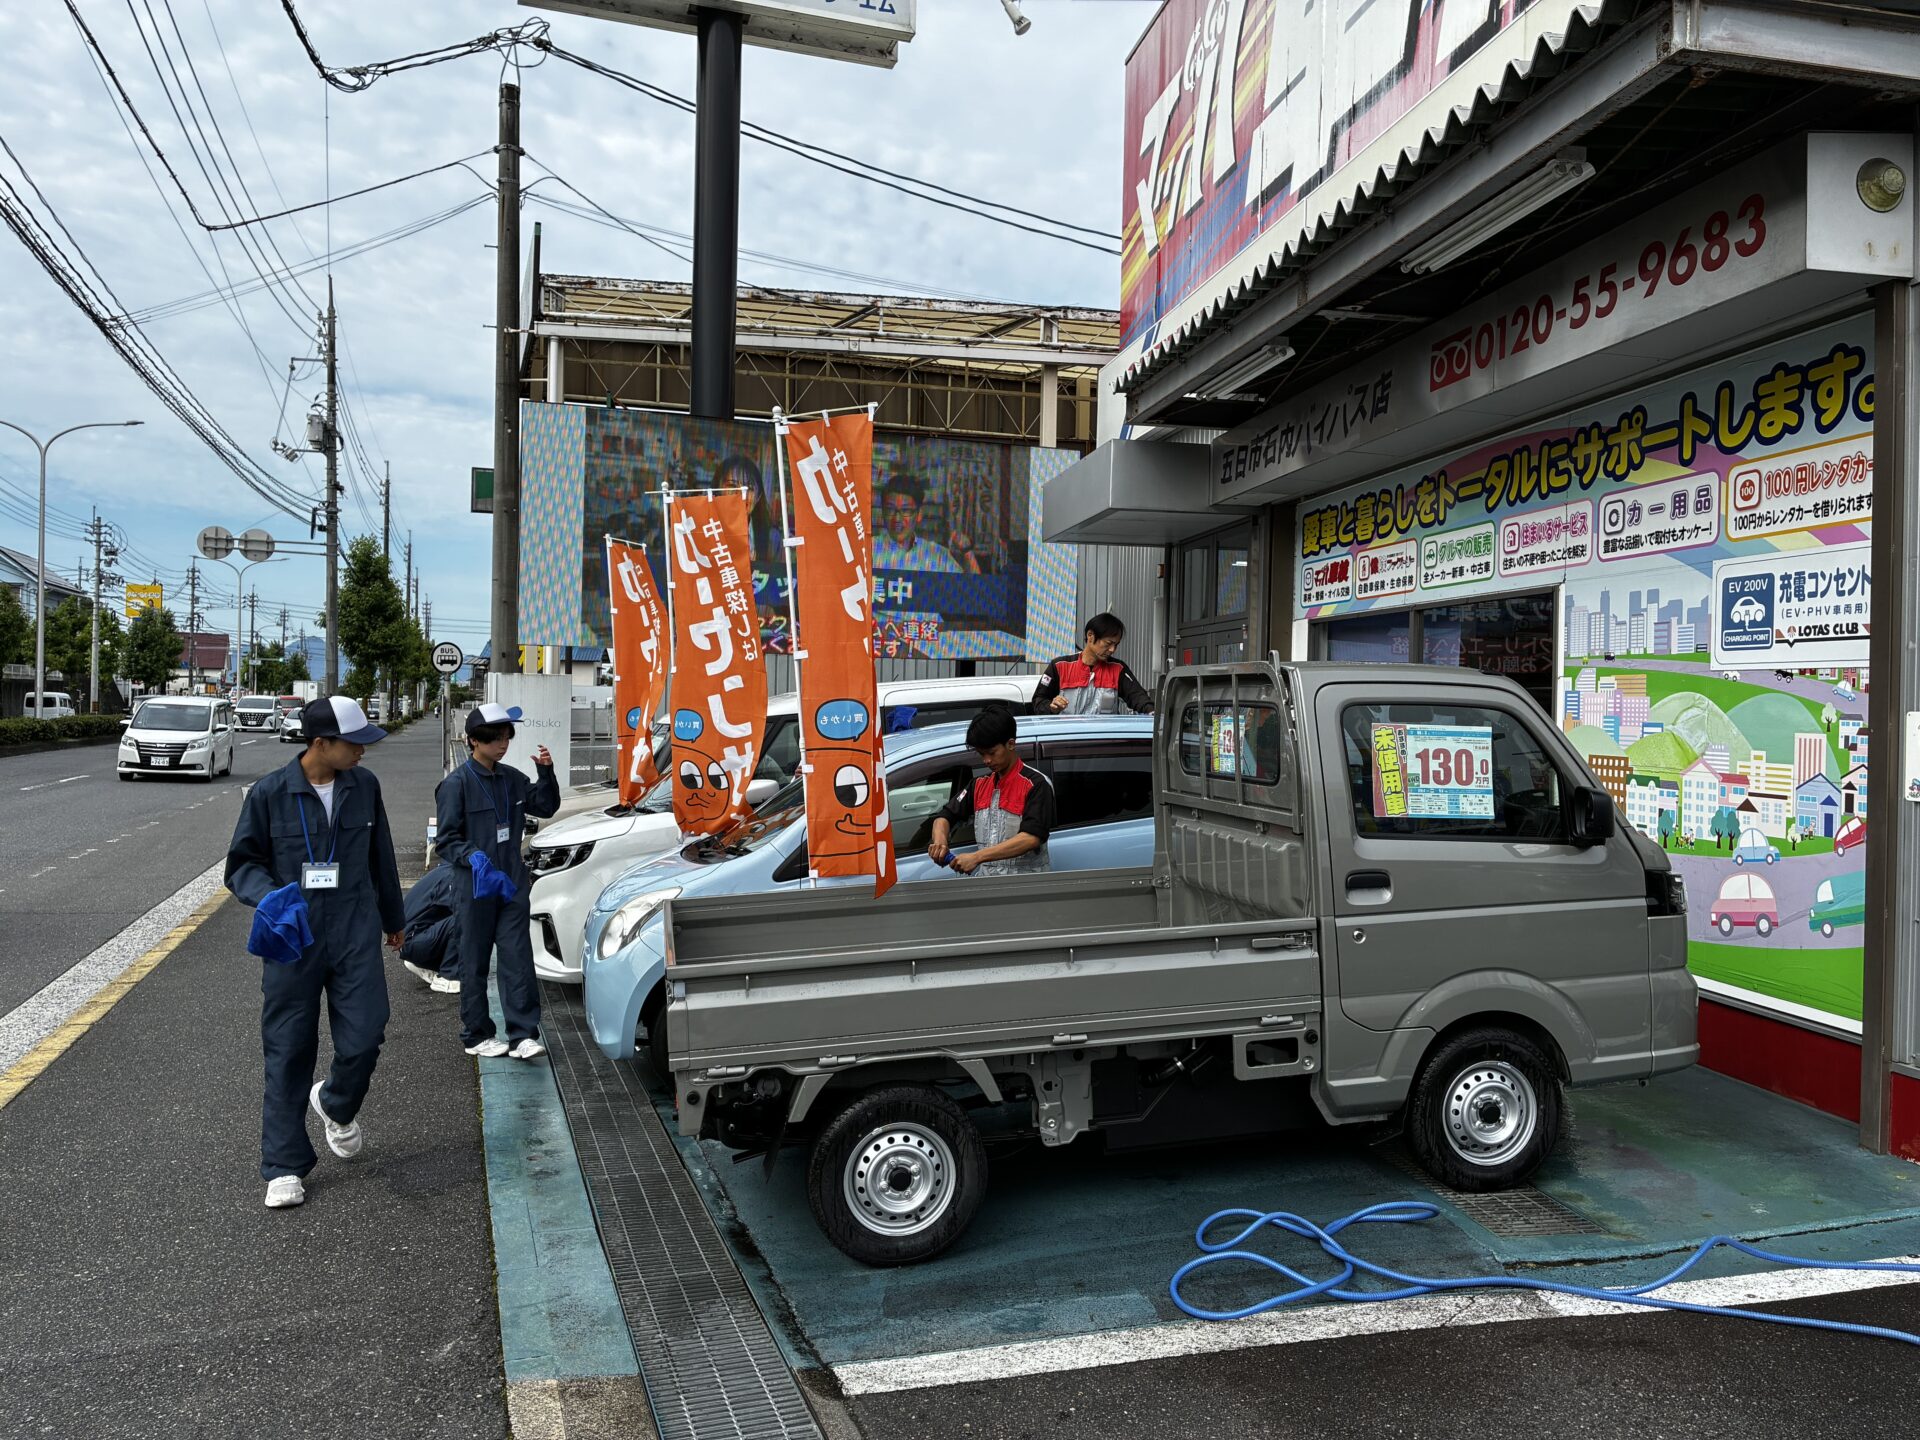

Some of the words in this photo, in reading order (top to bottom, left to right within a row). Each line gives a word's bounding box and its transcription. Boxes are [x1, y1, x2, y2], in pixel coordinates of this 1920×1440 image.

[1475, 193, 1767, 370] 0120-55-9683
[1221, 369, 1393, 484] 五日市石内バイパス店
[1302, 346, 1874, 557] 愛車と暮らしをトータルにサポートします。
[1627, 484, 1714, 526] カー用品
[1439, 531, 1492, 564] クルマの販売
[1521, 512, 1589, 549] 住まいるサービス
[1729, 583, 1742, 593] EV
[1744, 579, 1768, 591] 200V
[1779, 565, 1872, 604] 充電コンセント
[1725, 634, 1751, 643] CHARGING
[1752, 633, 1769, 642] POINT
[1798, 624, 1829, 637] LOTAS
[1833, 622, 1859, 635] CLUB
[1475, 776, 1490, 785] 万円
